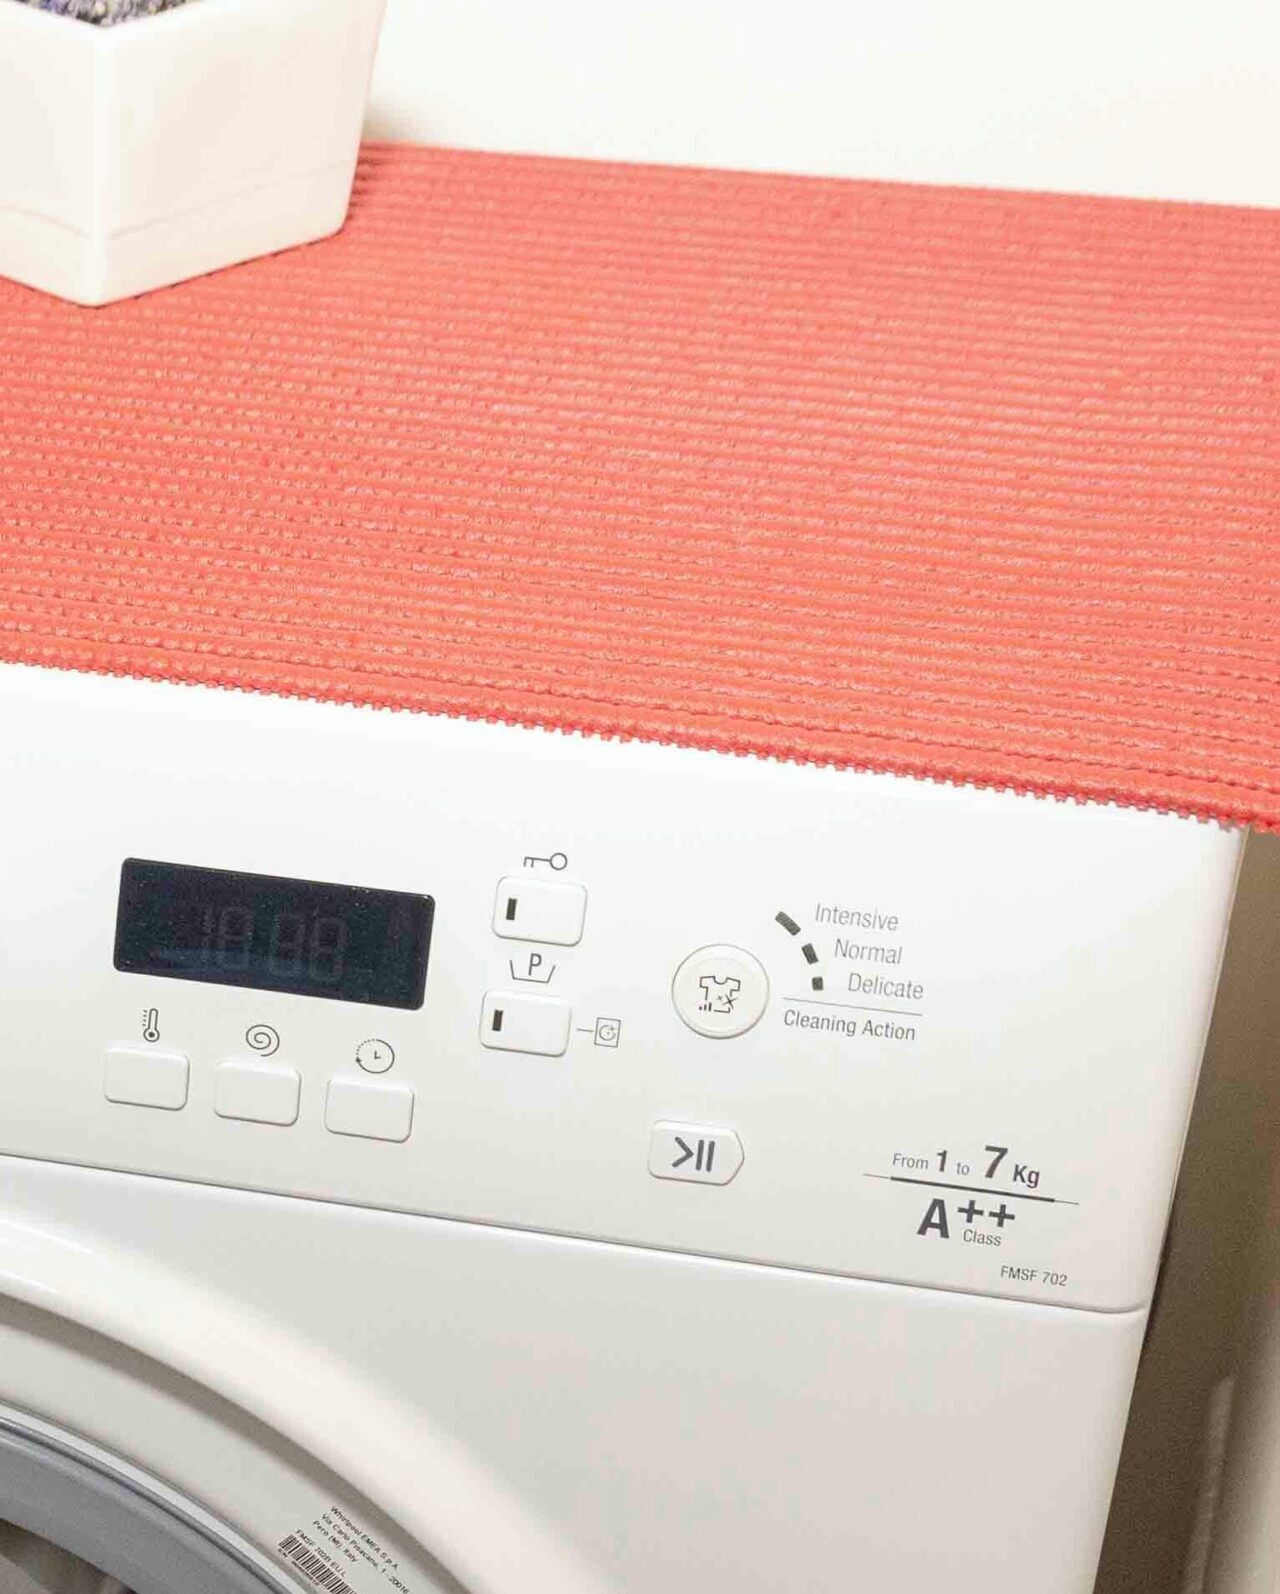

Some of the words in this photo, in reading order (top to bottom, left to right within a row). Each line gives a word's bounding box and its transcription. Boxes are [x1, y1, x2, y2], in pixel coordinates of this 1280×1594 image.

[815, 902, 899, 931] Intensive
[834, 938, 903, 965] Normal
[848, 972, 924, 1000] Delicate
[783, 1009, 856, 1037] Cleaning
[862, 1019, 916, 1041] Action
[892, 1153, 929, 1170] From
[936, 1150, 947, 1172] 1
[956, 1162, 970, 1176] to
[985, 1145, 1008, 1178] 7
[1013, 1163, 1040, 1189] Kg
[916, 1198, 1015, 1239] A++
[963, 1229, 1002, 1247] Class
[1000, 1265, 1038, 1282] FMSF
[1041, 1271, 1068, 1287] 702
